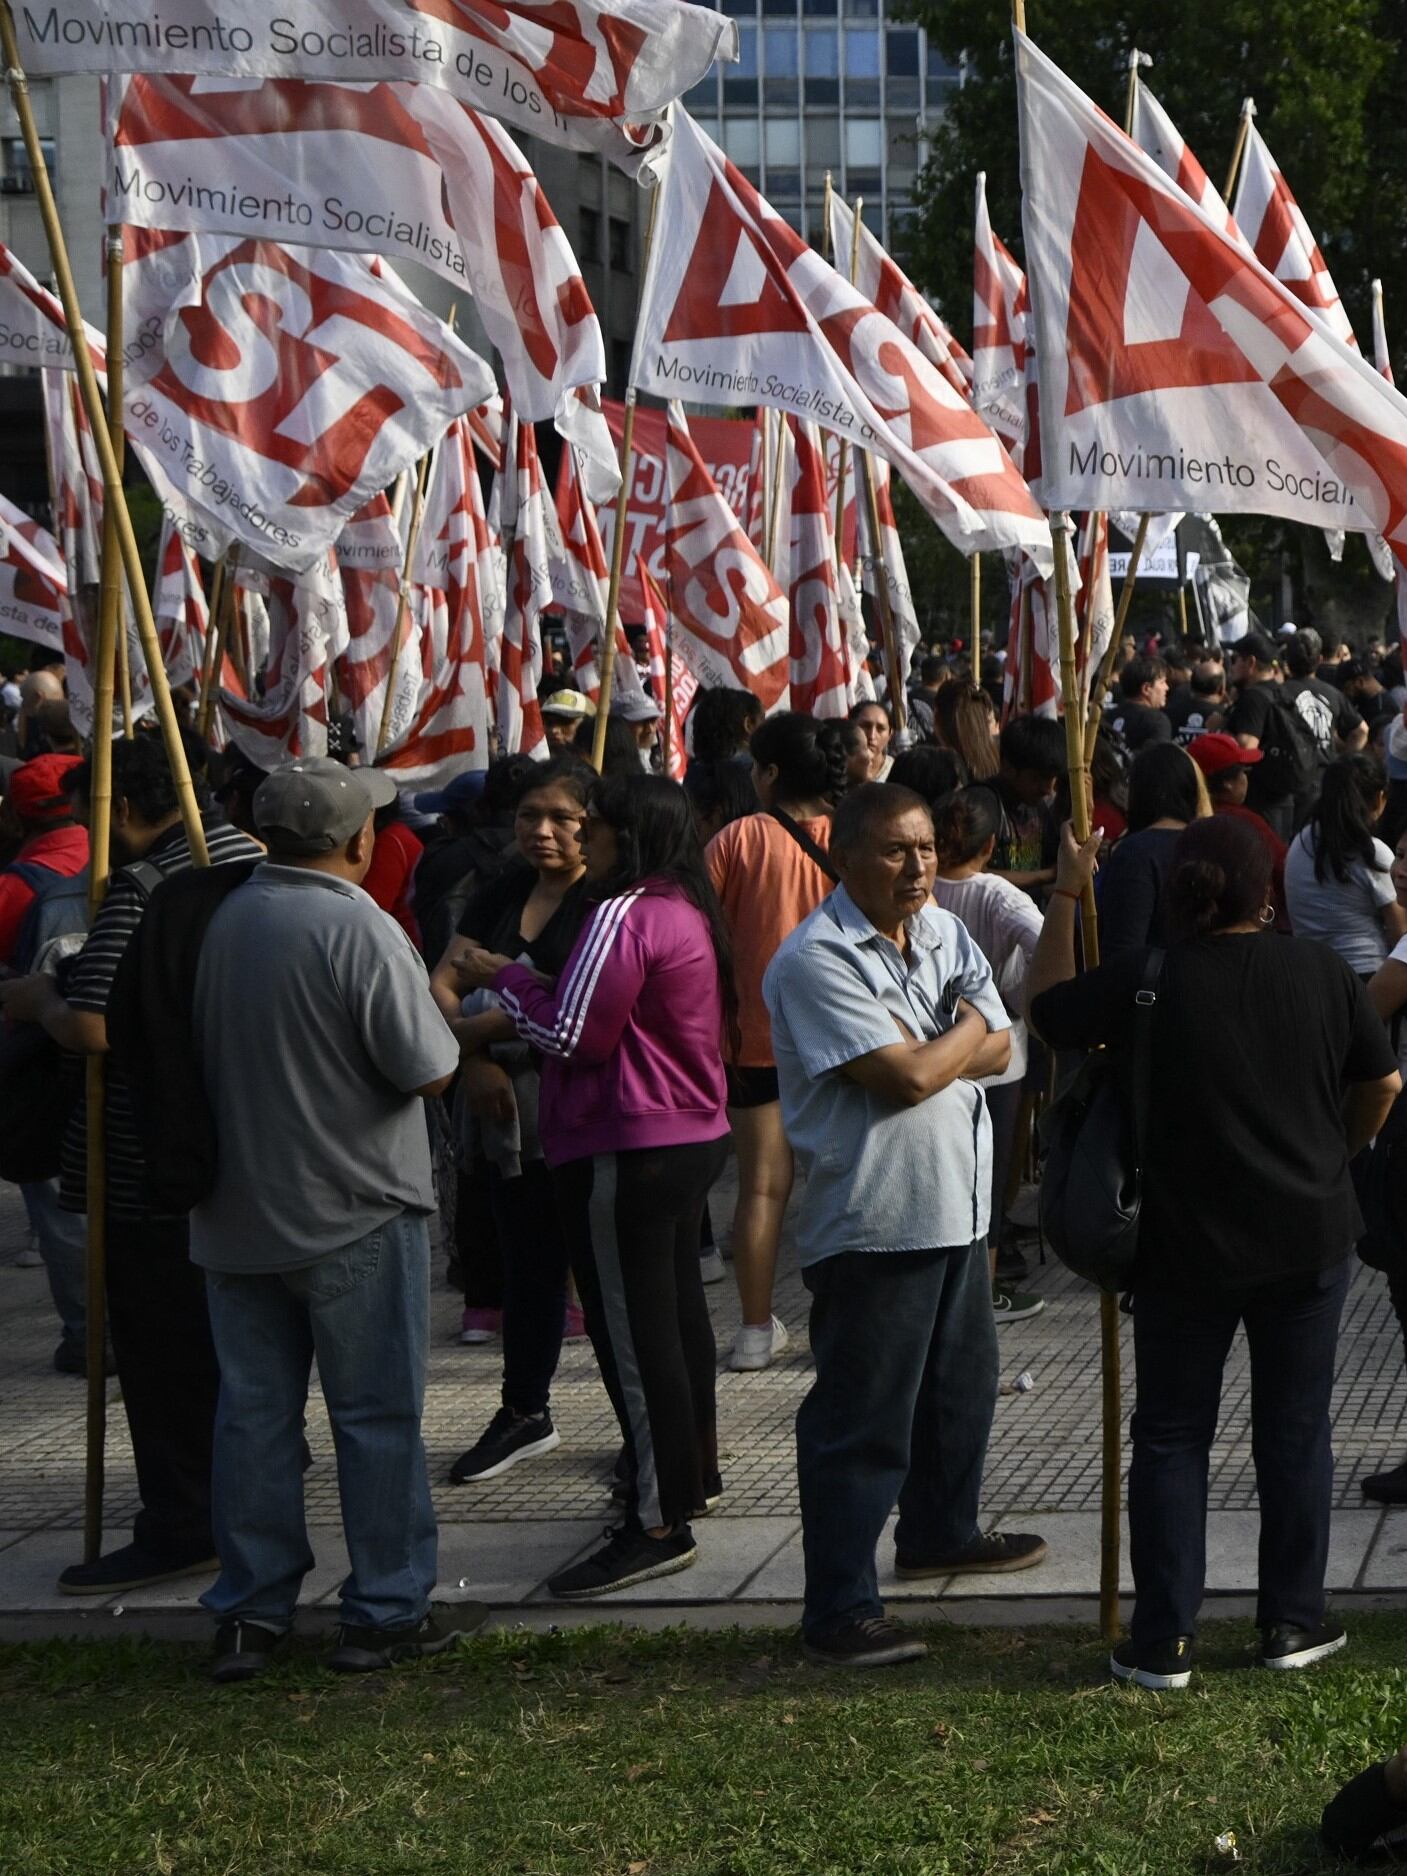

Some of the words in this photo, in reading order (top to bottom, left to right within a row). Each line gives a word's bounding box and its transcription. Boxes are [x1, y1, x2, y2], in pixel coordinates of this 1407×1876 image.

[24, 7, 253, 52] Movimiento
[269, 18, 445, 64] Socialista
[456, 48, 493, 87] de
[503, 67, 542, 114] los
[114, 166, 312, 226] Movimiento
[323, 197, 467, 276] Socialista
[759, 374, 854, 428] Socialista
[130, 399, 159, 428] de
[159, 419, 181, 450] los
[180, 441, 302, 548] Trabajadores
[1069, 441, 1255, 487] Movimiento
